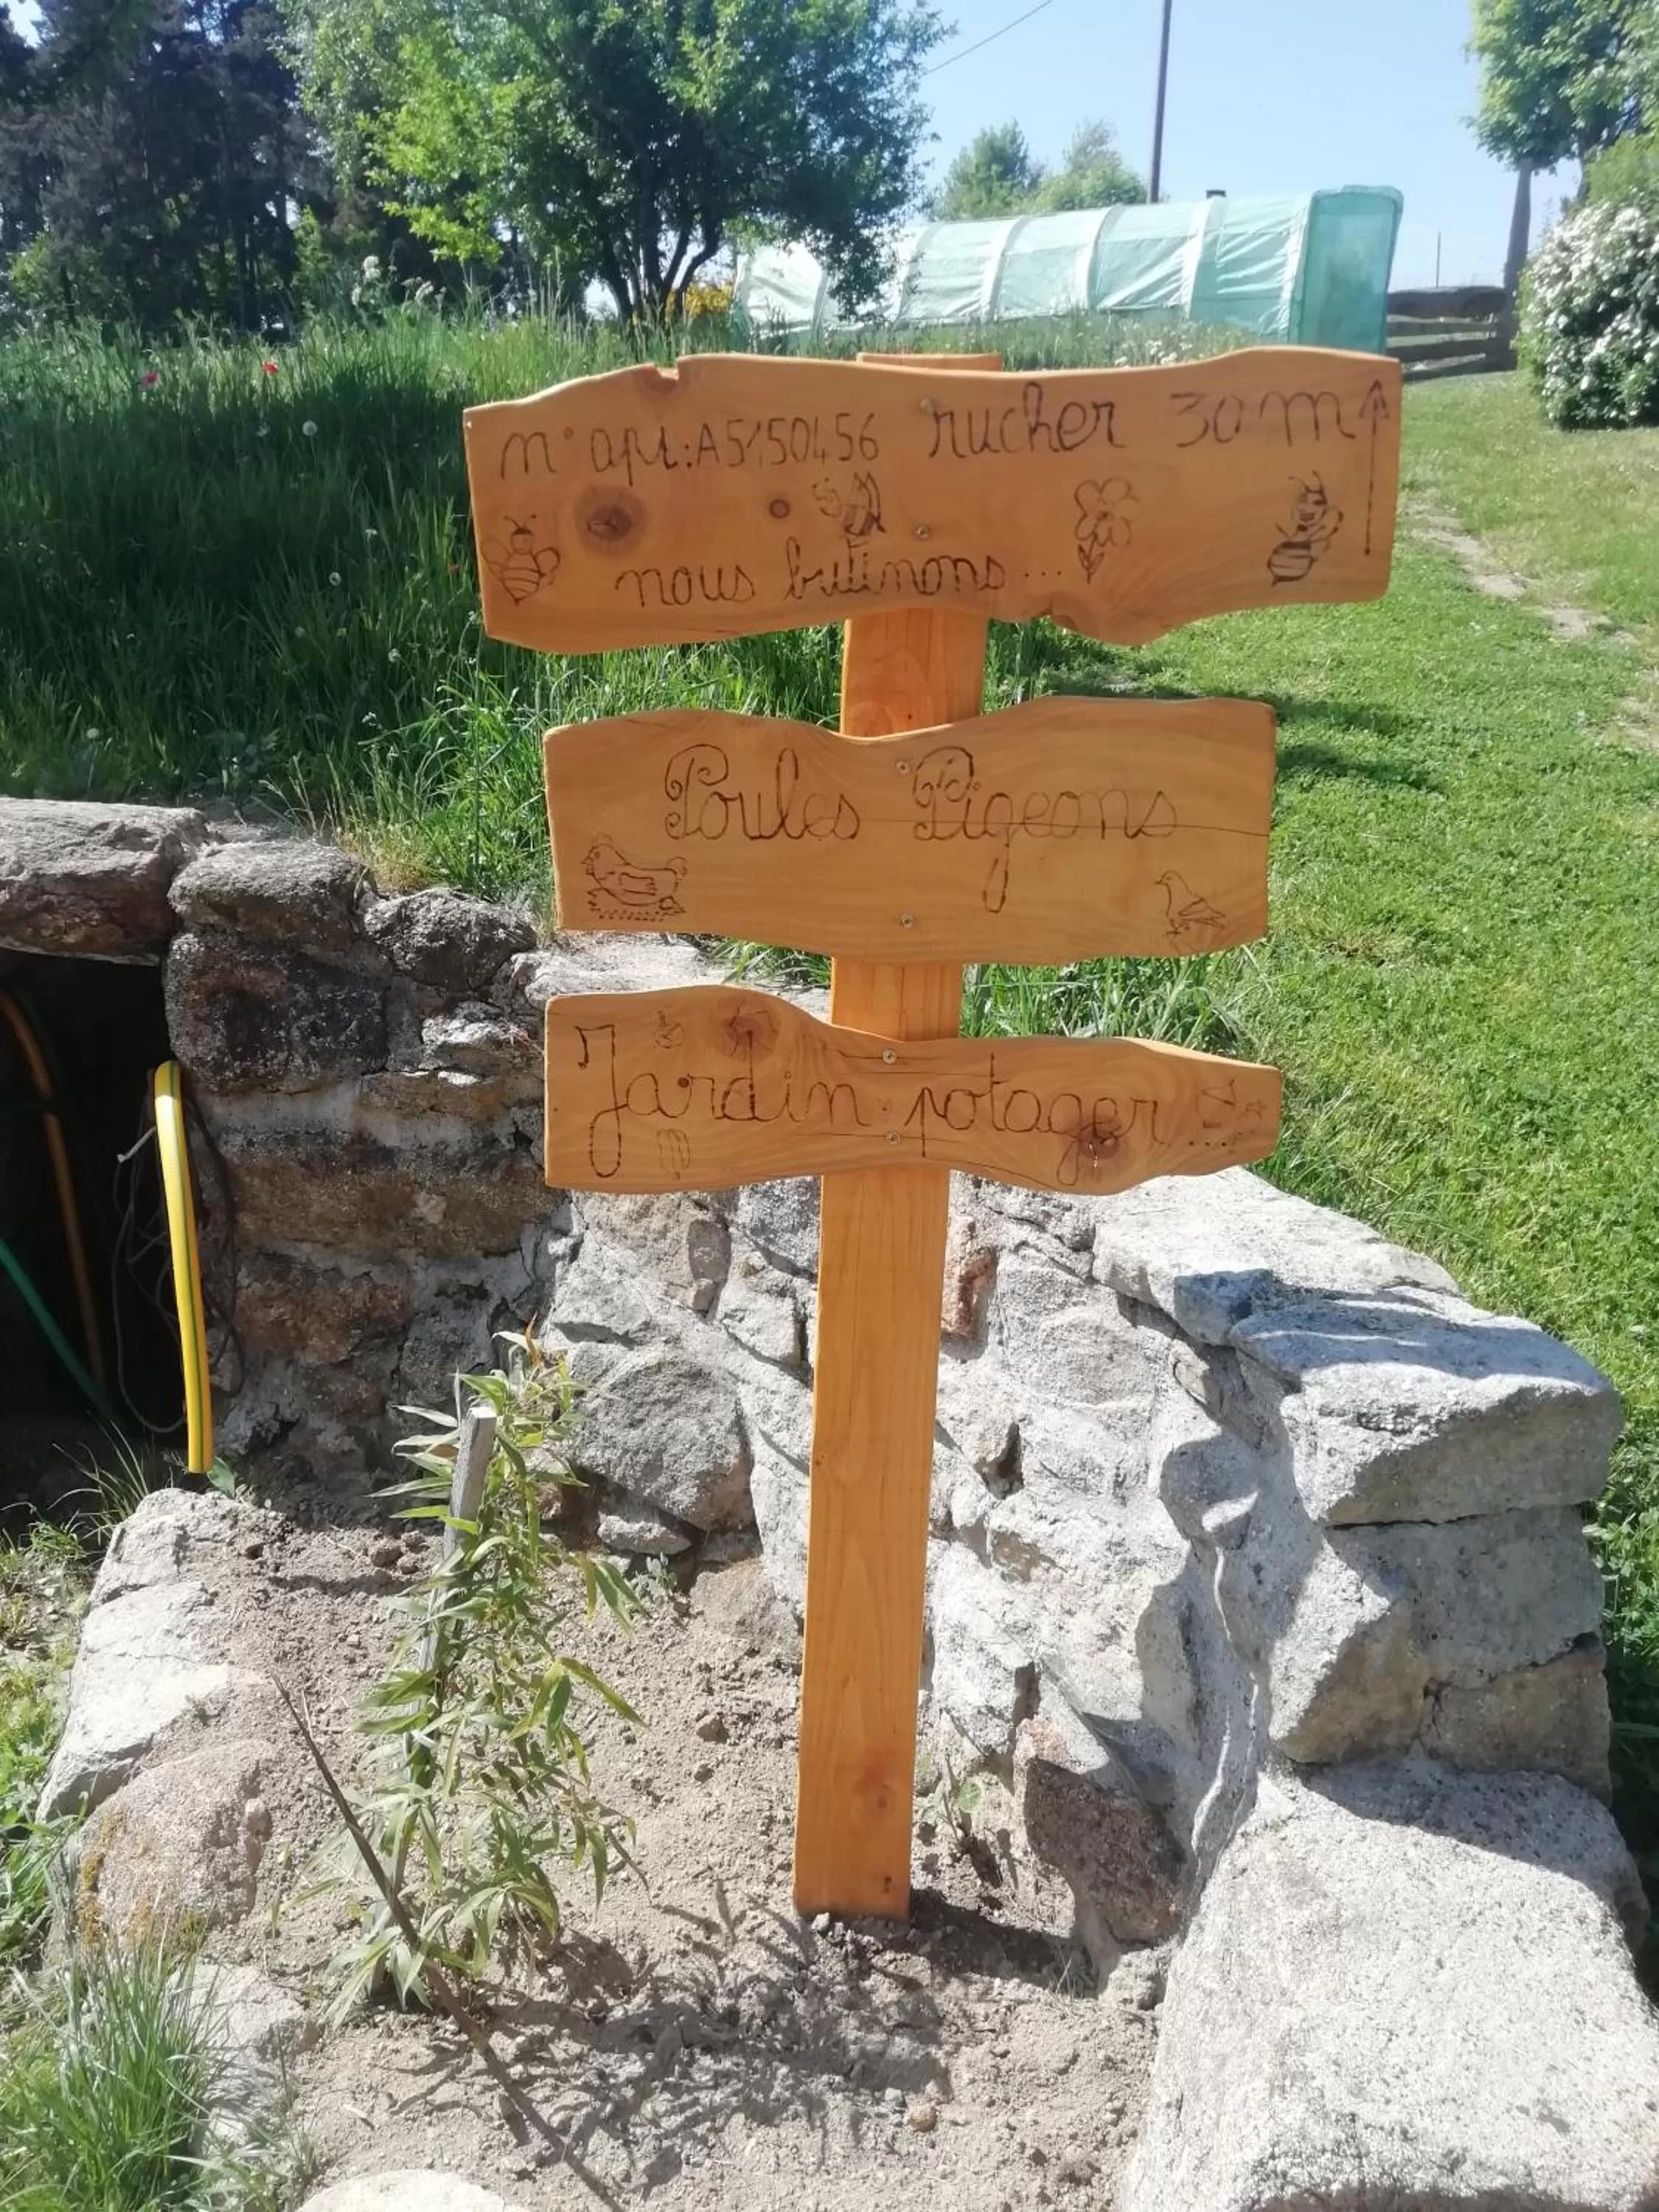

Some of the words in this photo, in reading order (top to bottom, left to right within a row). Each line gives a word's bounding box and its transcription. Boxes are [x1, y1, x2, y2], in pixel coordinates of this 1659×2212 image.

[929, 381, 1125, 459] rucher
[615, 564, 756, 608] nous
[664, 743, 860, 841] Poules
[913, 746, 1178, 914] Pigeons
[574, 1023, 871, 1178] Jardin
